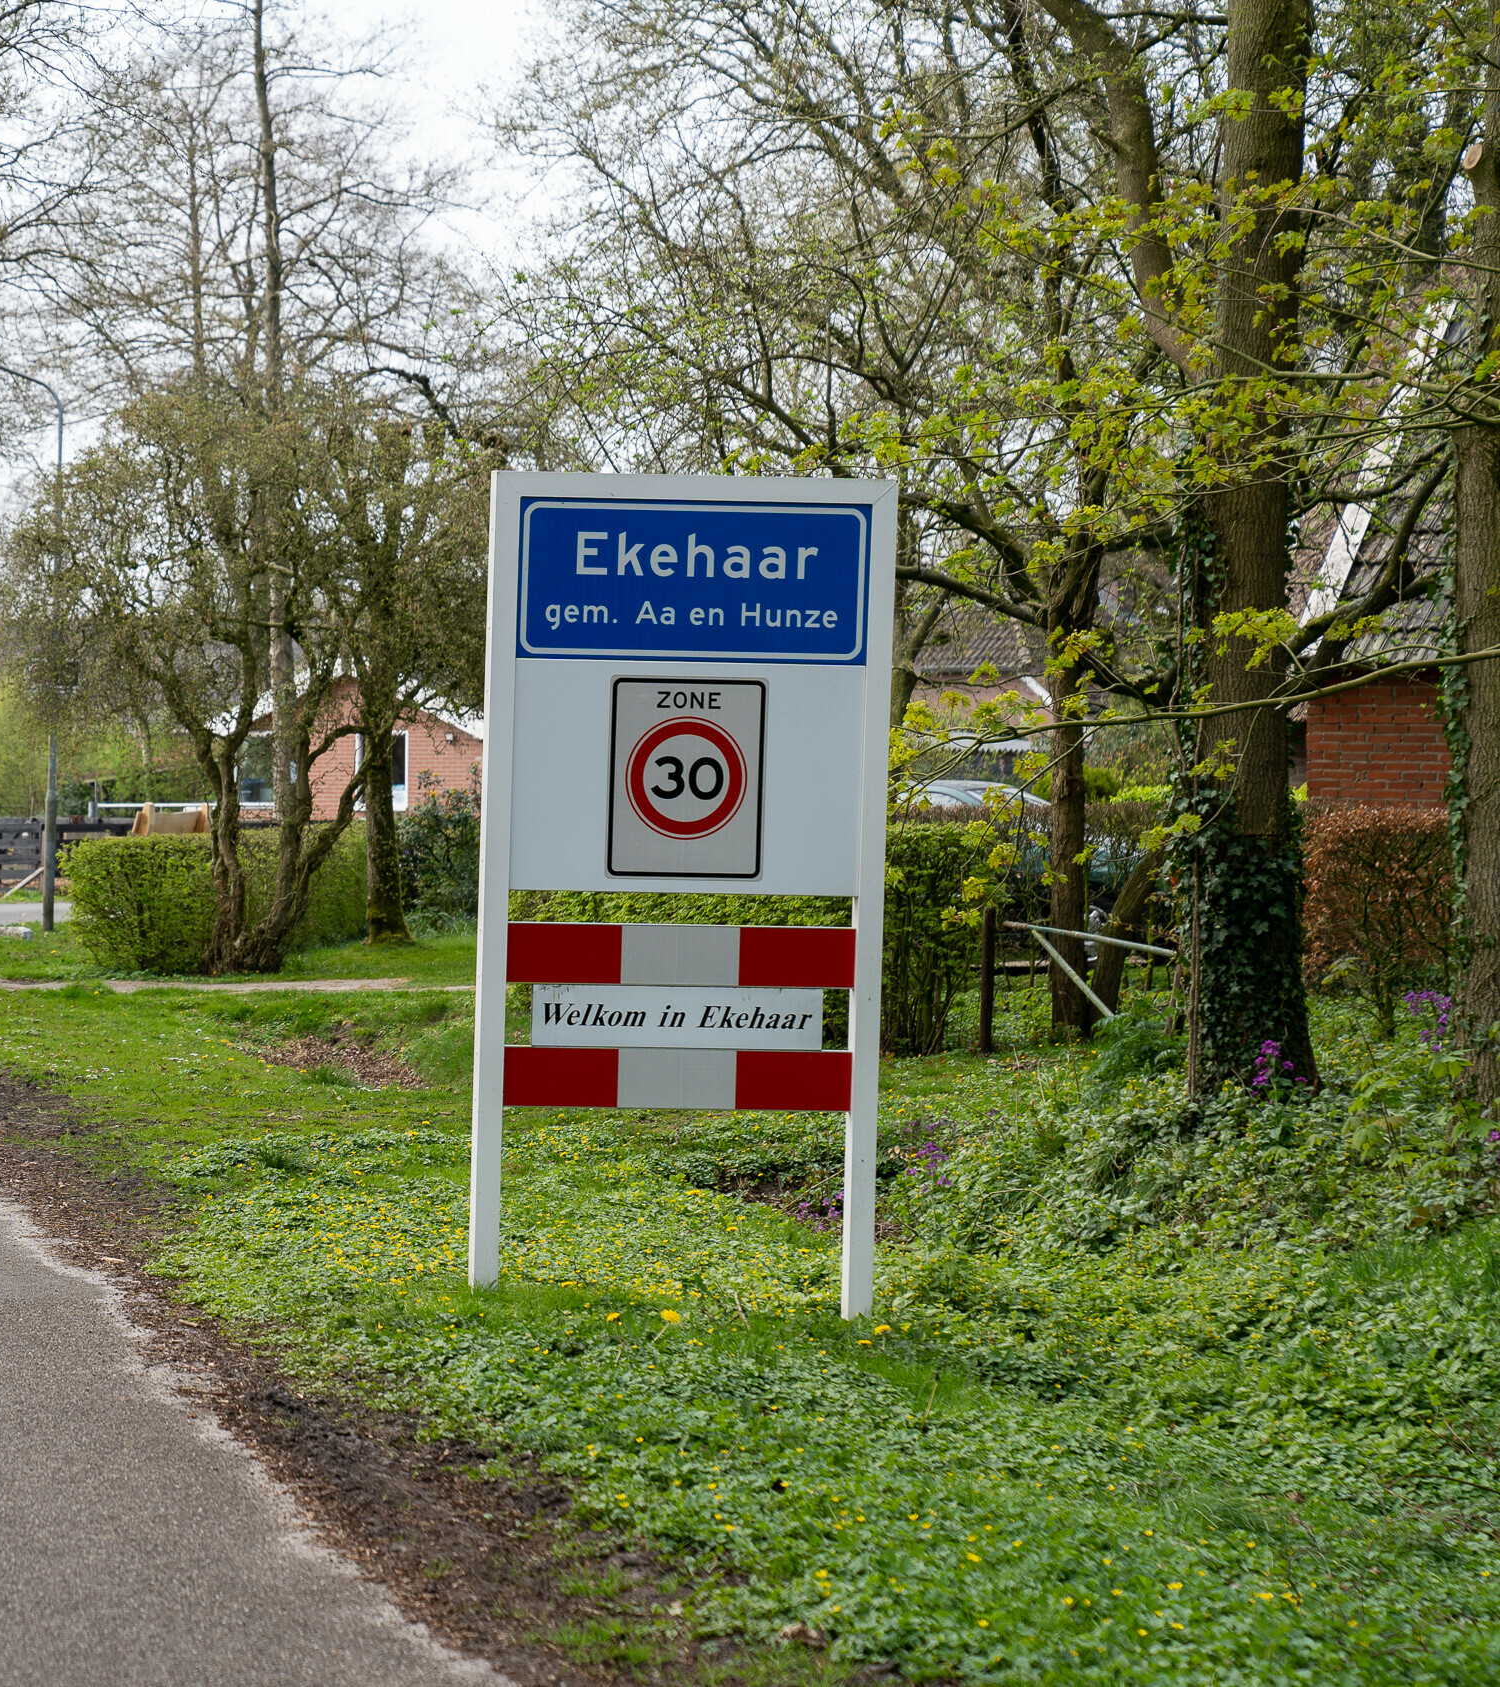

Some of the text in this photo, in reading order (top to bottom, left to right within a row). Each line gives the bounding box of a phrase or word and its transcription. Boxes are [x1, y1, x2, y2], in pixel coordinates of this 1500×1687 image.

[576, 531, 819, 580] Ekehaar
[545, 600, 838, 631] gem. Aa en Hunze
[656, 691, 721, 710] ZONE
[651, 756, 724, 800] 30
[543, 1002, 813, 1030] Welkom in Ekehaar
